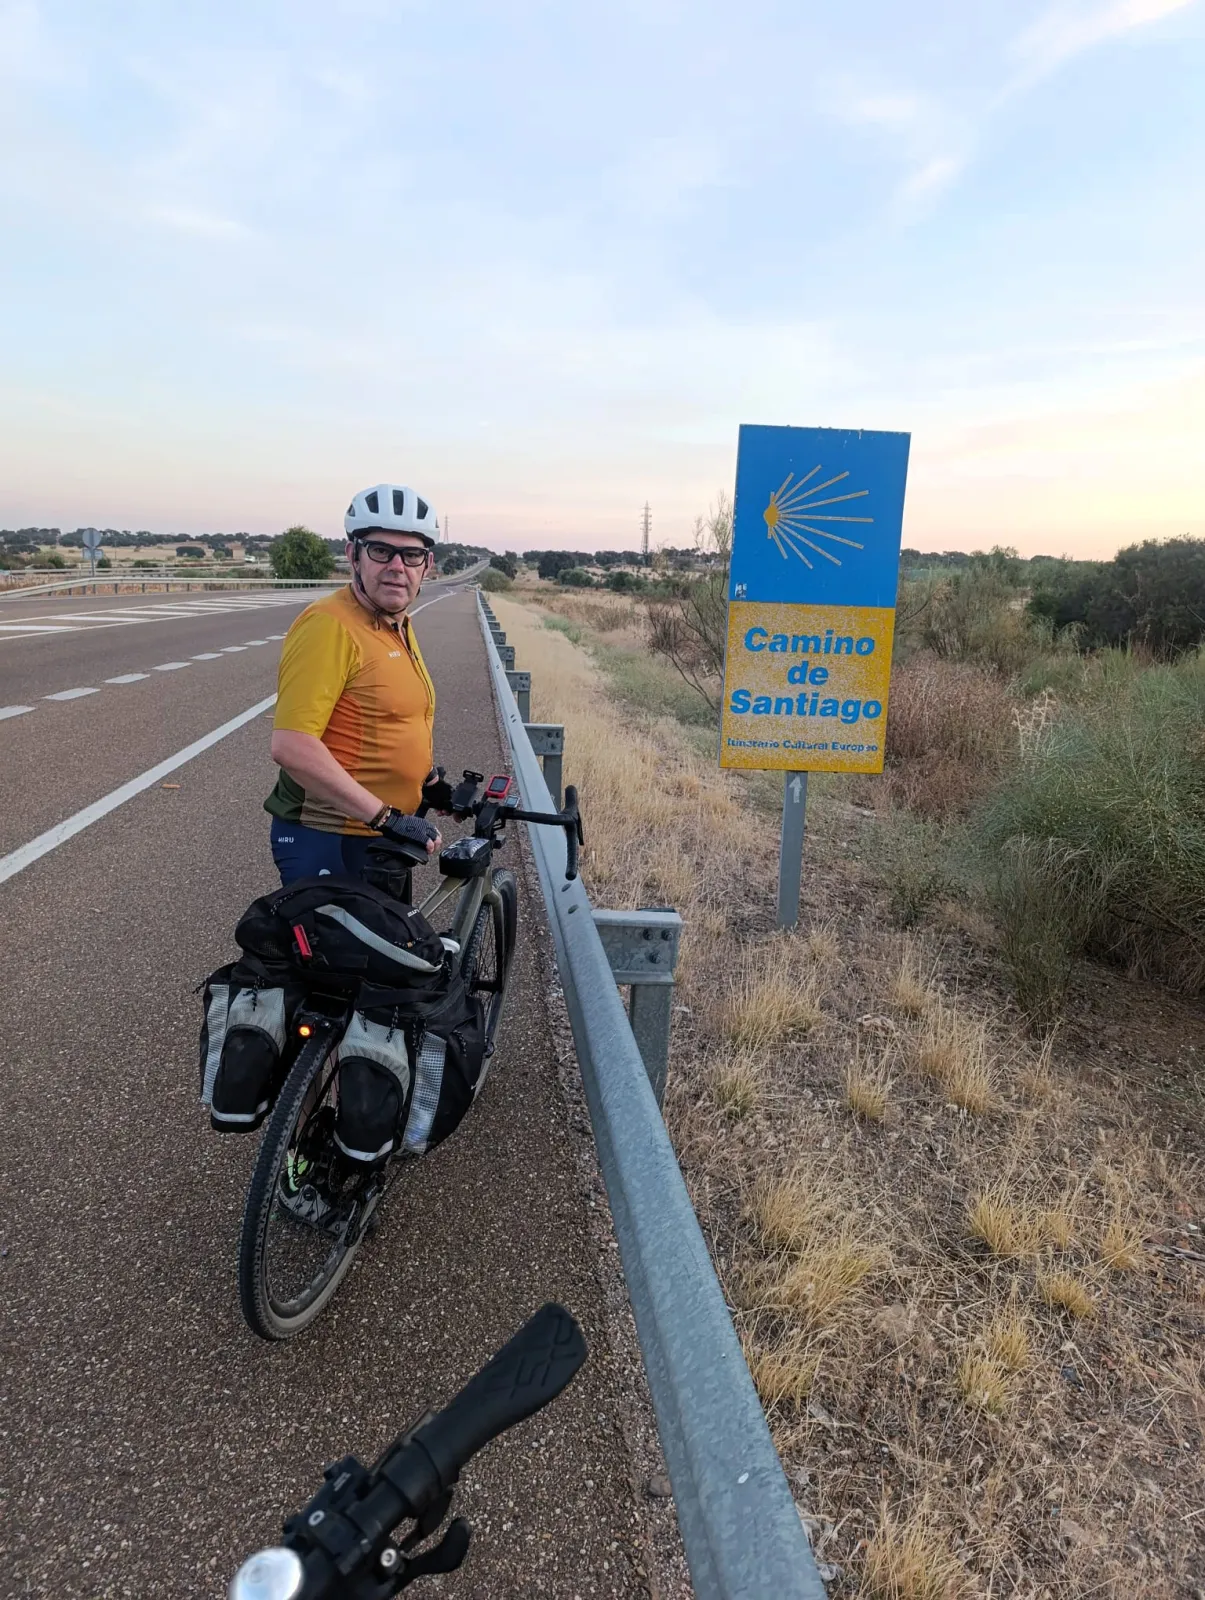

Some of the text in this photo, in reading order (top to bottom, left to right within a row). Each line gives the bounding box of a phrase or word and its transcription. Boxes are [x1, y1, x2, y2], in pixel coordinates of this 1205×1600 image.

[744, 626, 875, 656] Camino
[787, 660, 829, 685] de
[730, 689, 882, 724] Santiago
